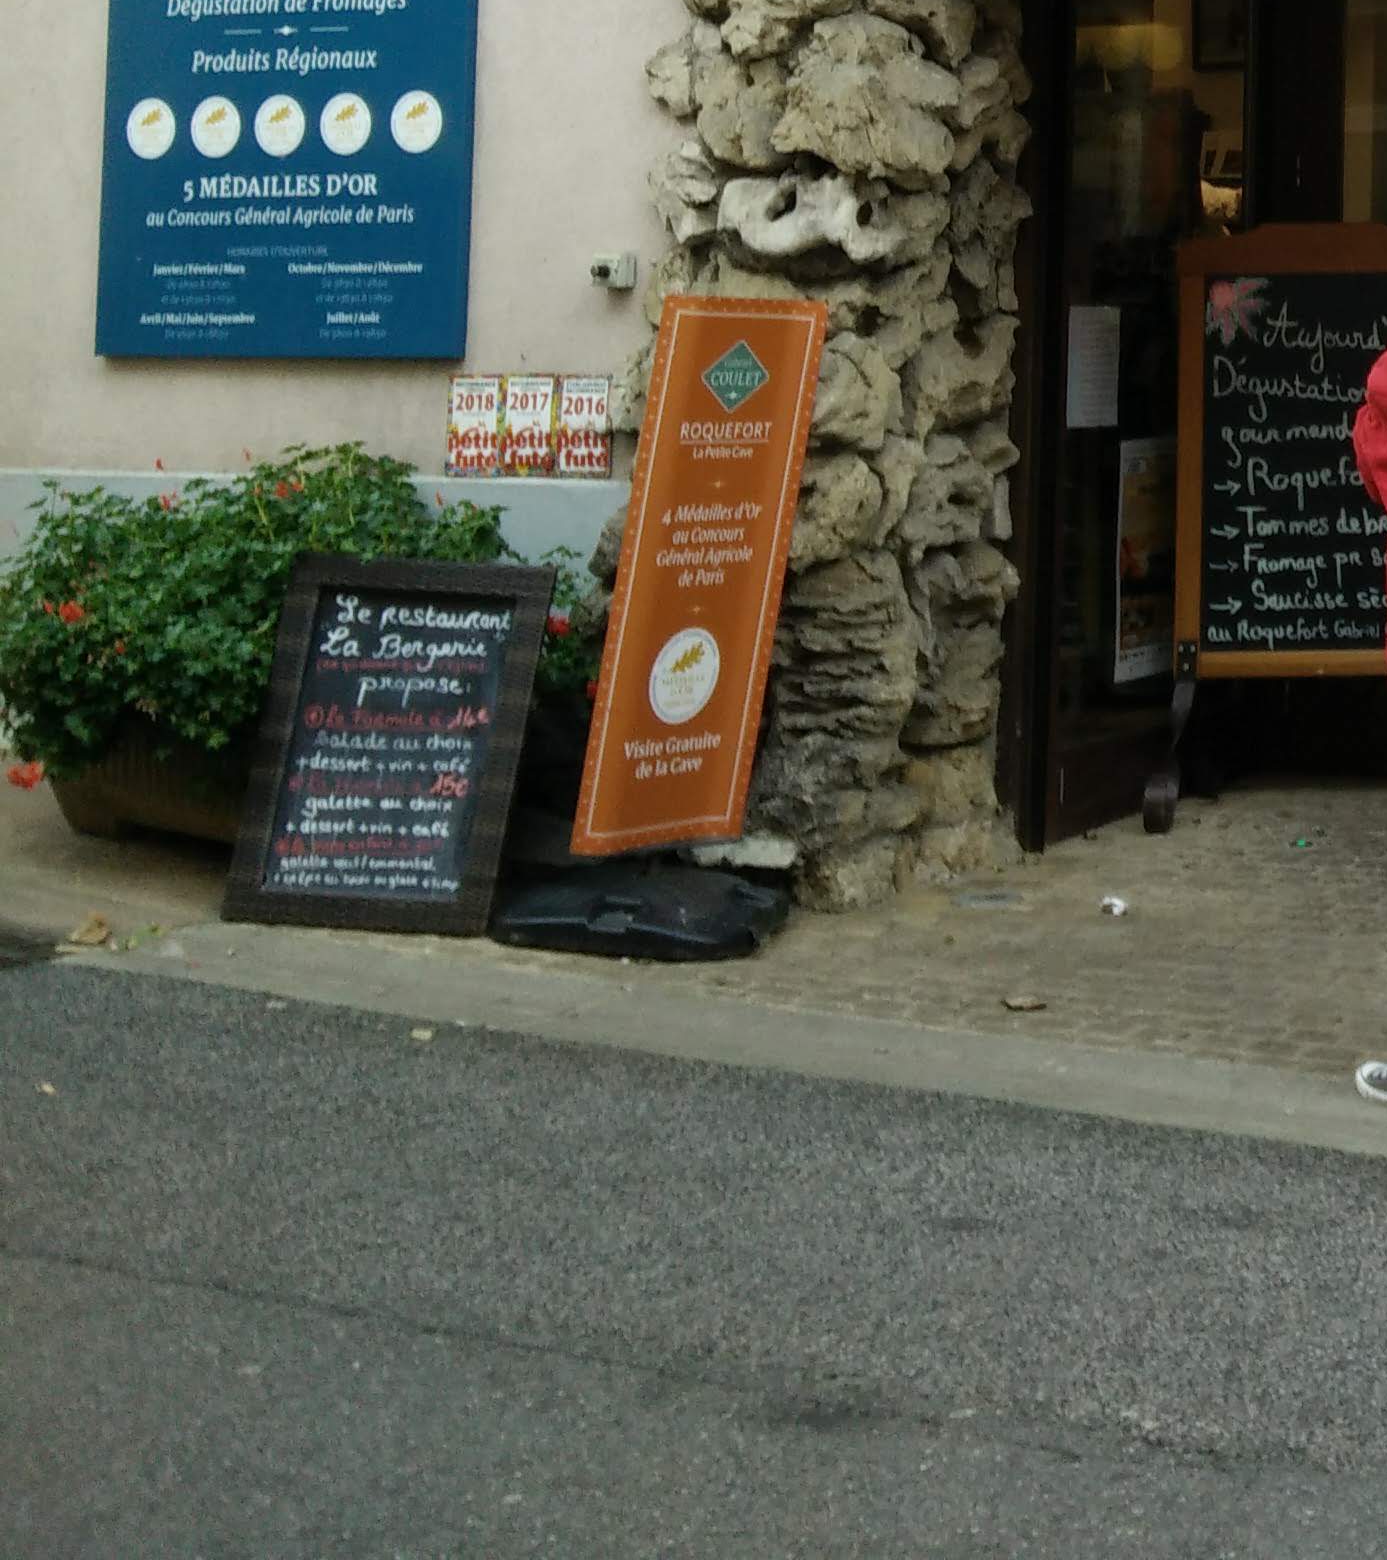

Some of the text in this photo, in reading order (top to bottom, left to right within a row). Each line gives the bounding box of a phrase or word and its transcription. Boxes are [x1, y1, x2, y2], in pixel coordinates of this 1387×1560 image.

[191, 44, 378, 77] Produits Régionaux
[183, 173, 378, 203] 5 MÉDAILLES D'OR
[146, 203, 415, 229] au Concours Général Agricole de Paris
[710, 371, 762, 386] COULET
[455, 392, 495, 411] 2018
[509, 392, 549, 411] 2017
[563, 396, 605, 416] 2016
[680, 421, 773, 441] ROQUEFORT
[674, 503, 733, 522] Médailles
[673, 526, 745, 545] au Concours
[656, 544, 752, 567] Général Agricole
[678, 568, 725, 587] de Paris
[1251, 578, 1348, 611] Saucisse
[379, 605, 513, 632] restaurant
[1208, 625, 1233, 642] au
[1237, 618, 1329, 651] Roquefort
[320, 627, 361, 657] La
[372, 634, 488, 673] Bergerie
[624, 731, 722, 760] Visite Gratuite
[635, 755, 703, 780] de la Cave
